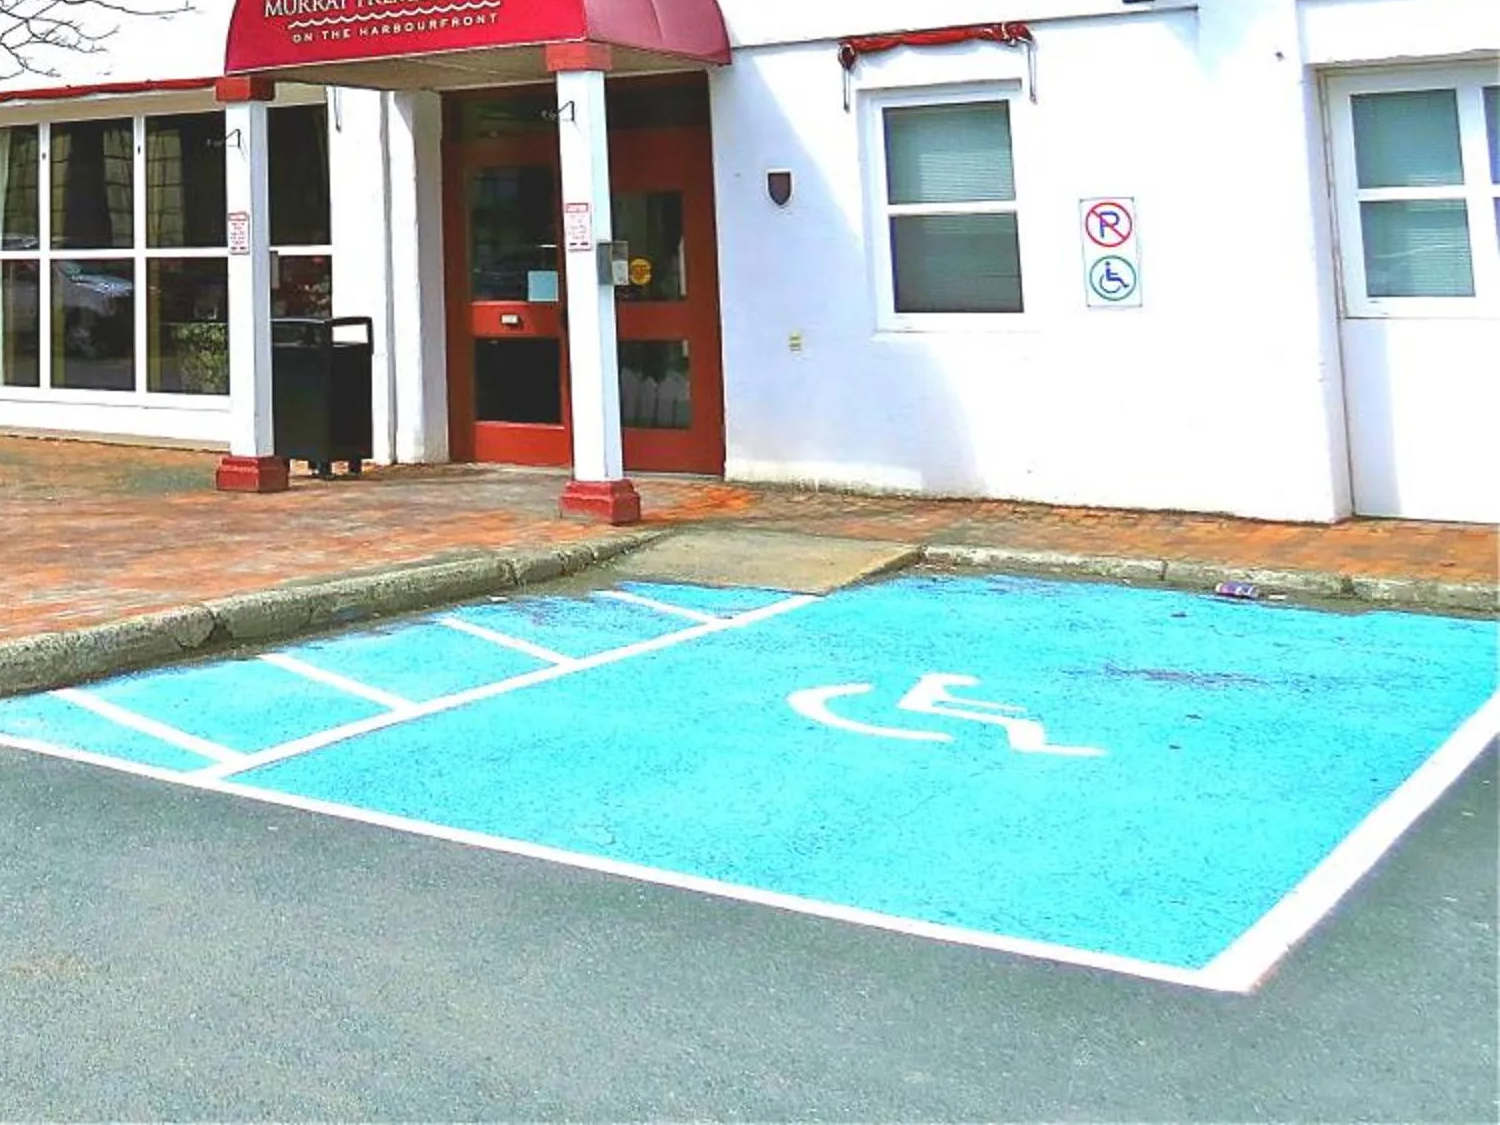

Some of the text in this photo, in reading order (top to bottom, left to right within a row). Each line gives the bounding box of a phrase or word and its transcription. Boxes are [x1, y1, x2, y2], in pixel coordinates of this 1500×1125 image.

[291, 12, 498, 44] ON THE HARBOURFRONT
